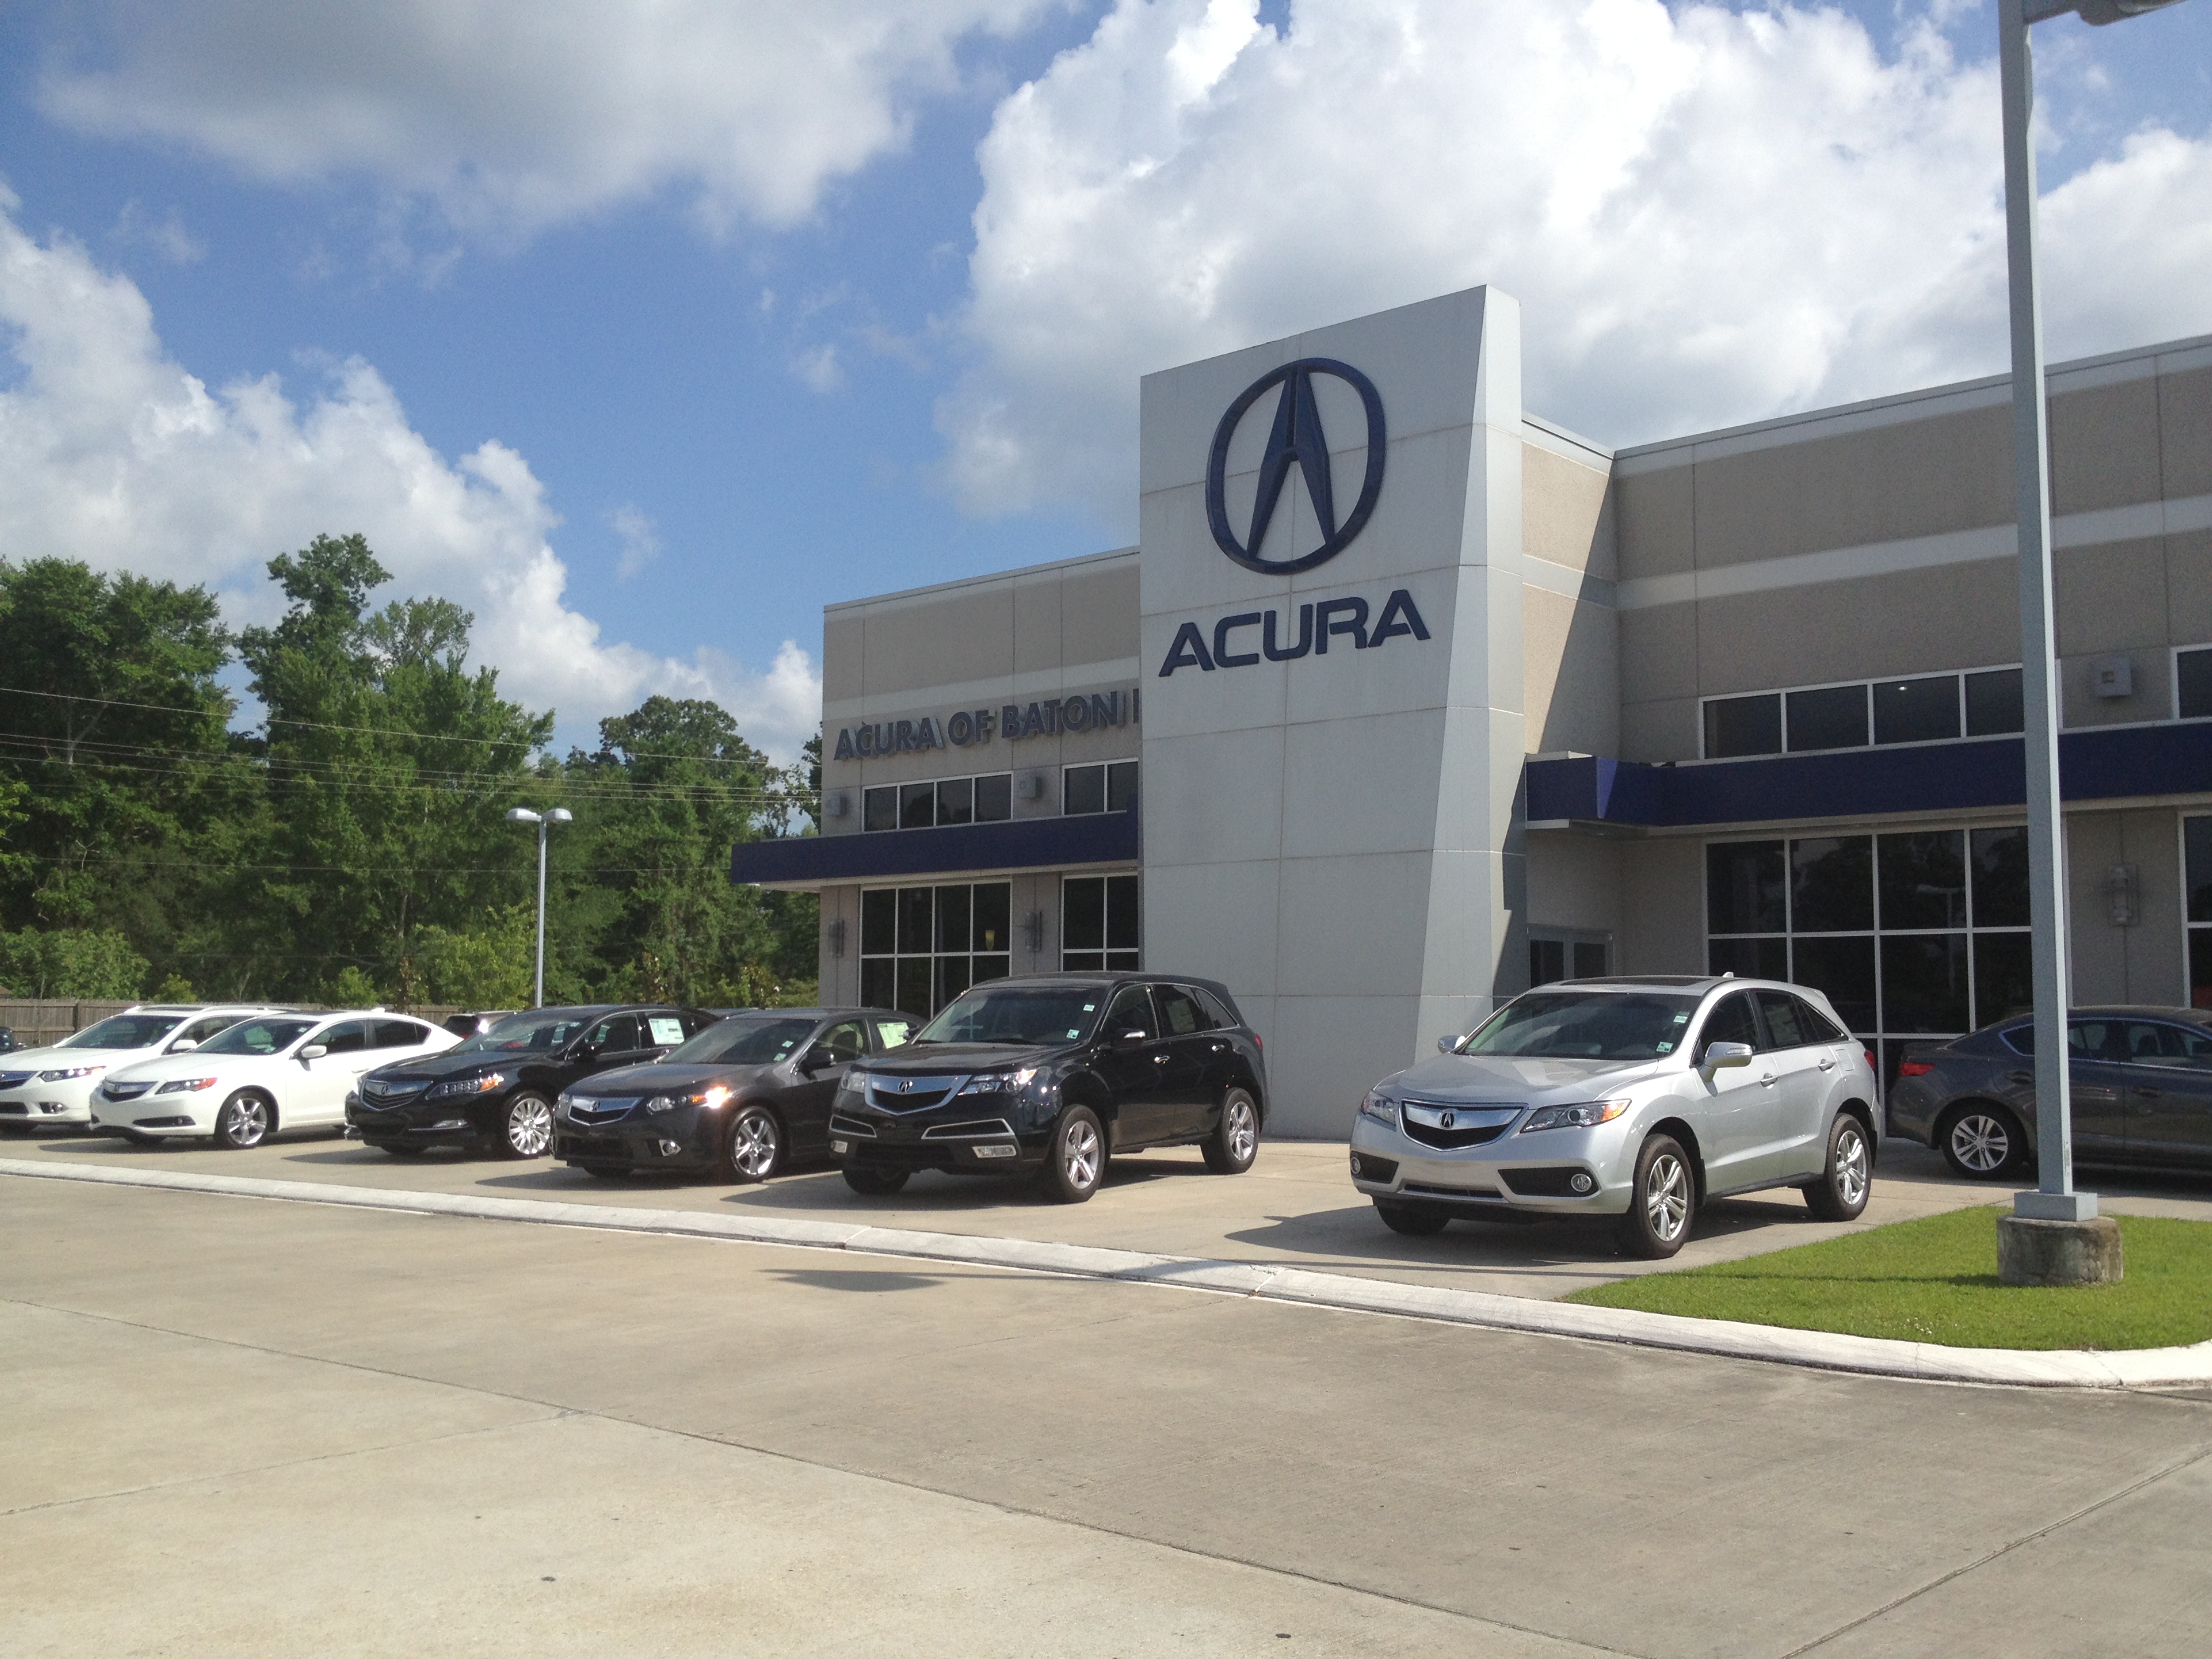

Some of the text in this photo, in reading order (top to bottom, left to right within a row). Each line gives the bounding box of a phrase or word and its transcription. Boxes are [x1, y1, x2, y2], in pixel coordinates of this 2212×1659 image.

[1158, 589, 1430, 677] ACURA
[834, 717, 939, 760] ACURA
[948, 710, 989, 746] OF
[1002, 691, 1118, 739] BATON
